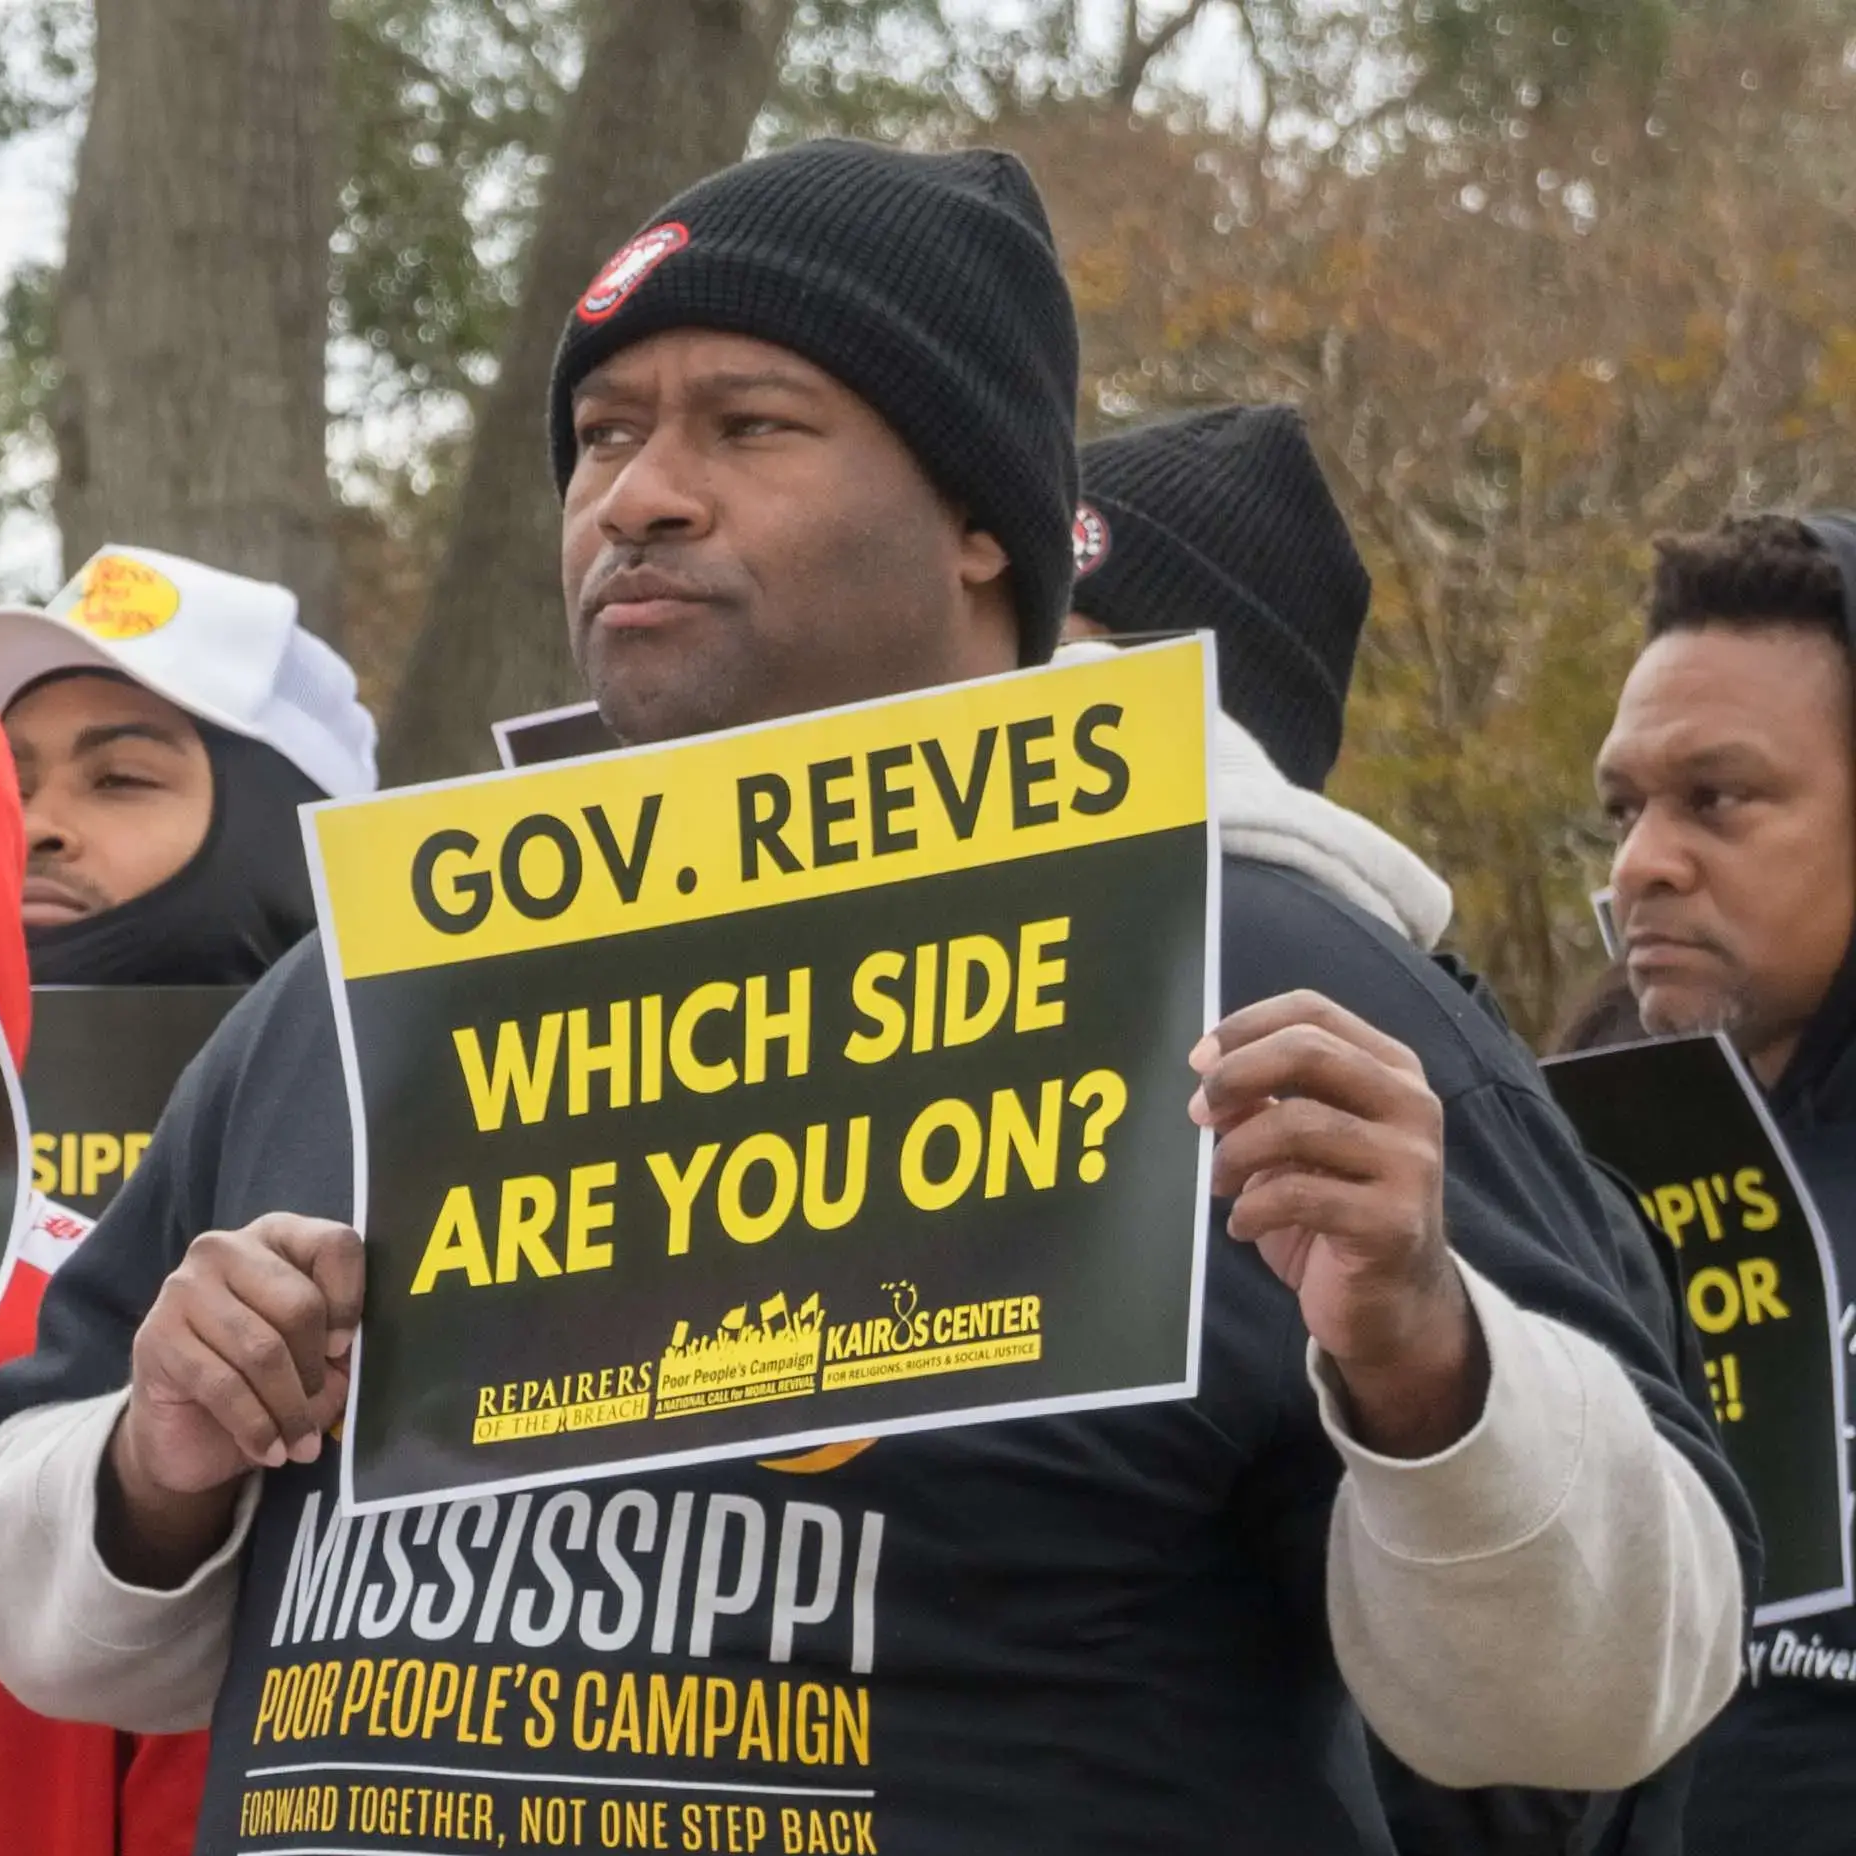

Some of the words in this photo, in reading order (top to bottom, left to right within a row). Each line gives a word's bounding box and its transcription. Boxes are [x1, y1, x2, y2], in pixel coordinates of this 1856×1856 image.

[410, 793, 699, 934] GOV.
[737, 702, 1130, 882] REEVES
[452, 968, 811, 1132] WHICH
[844, 915, 1071, 1064] SIDE
[410, 1161, 617, 1296] ARE
[645, 1114, 872, 1255] YOU
[898, 1068, 1129, 1211] ON?
[933, 1295, 1041, 1344] CENTER
[477, 1360, 653, 1418] REPAIRERS
[662, 1371, 690, 1392] Poor
[692, 1362, 747, 1389] People's
[750, 1352, 814, 1377] Campaign
[827, 1370, 846, 1383] FOR
[848, 1363, 903, 1381] RELIGIONS,
[906, 1357, 943, 1371] RIGHTS
[954, 1350, 990, 1365] SOCIAL
[993, 1343, 1036, 1358] JUSTICE
[478, 1421, 506, 1439] OF
[512, 1413, 550, 1435] THE
[573, 1397, 646, 1427] BREACH
[663, 1394, 707, 1412] NATIONAL
[708, 1390, 730, 1407] CALL
[270, 1489, 885, 1674] MISSISSIPPI
[253, 1659, 342, 1745] POOR
[340, 1658, 560, 1748] PEOPLE'S
[572, 1670, 870, 1766] CAMPAIGN
[240, 1785, 338, 1838] FORWARD
[348, 1785, 507, 1850] TOGETHER,
[520, 1796, 586, 1847] NOT
[600, 1800, 668, 1849] ONE
[681, 1803, 767, 1853] STEP
[781, 1807, 877, 1855] BACK
